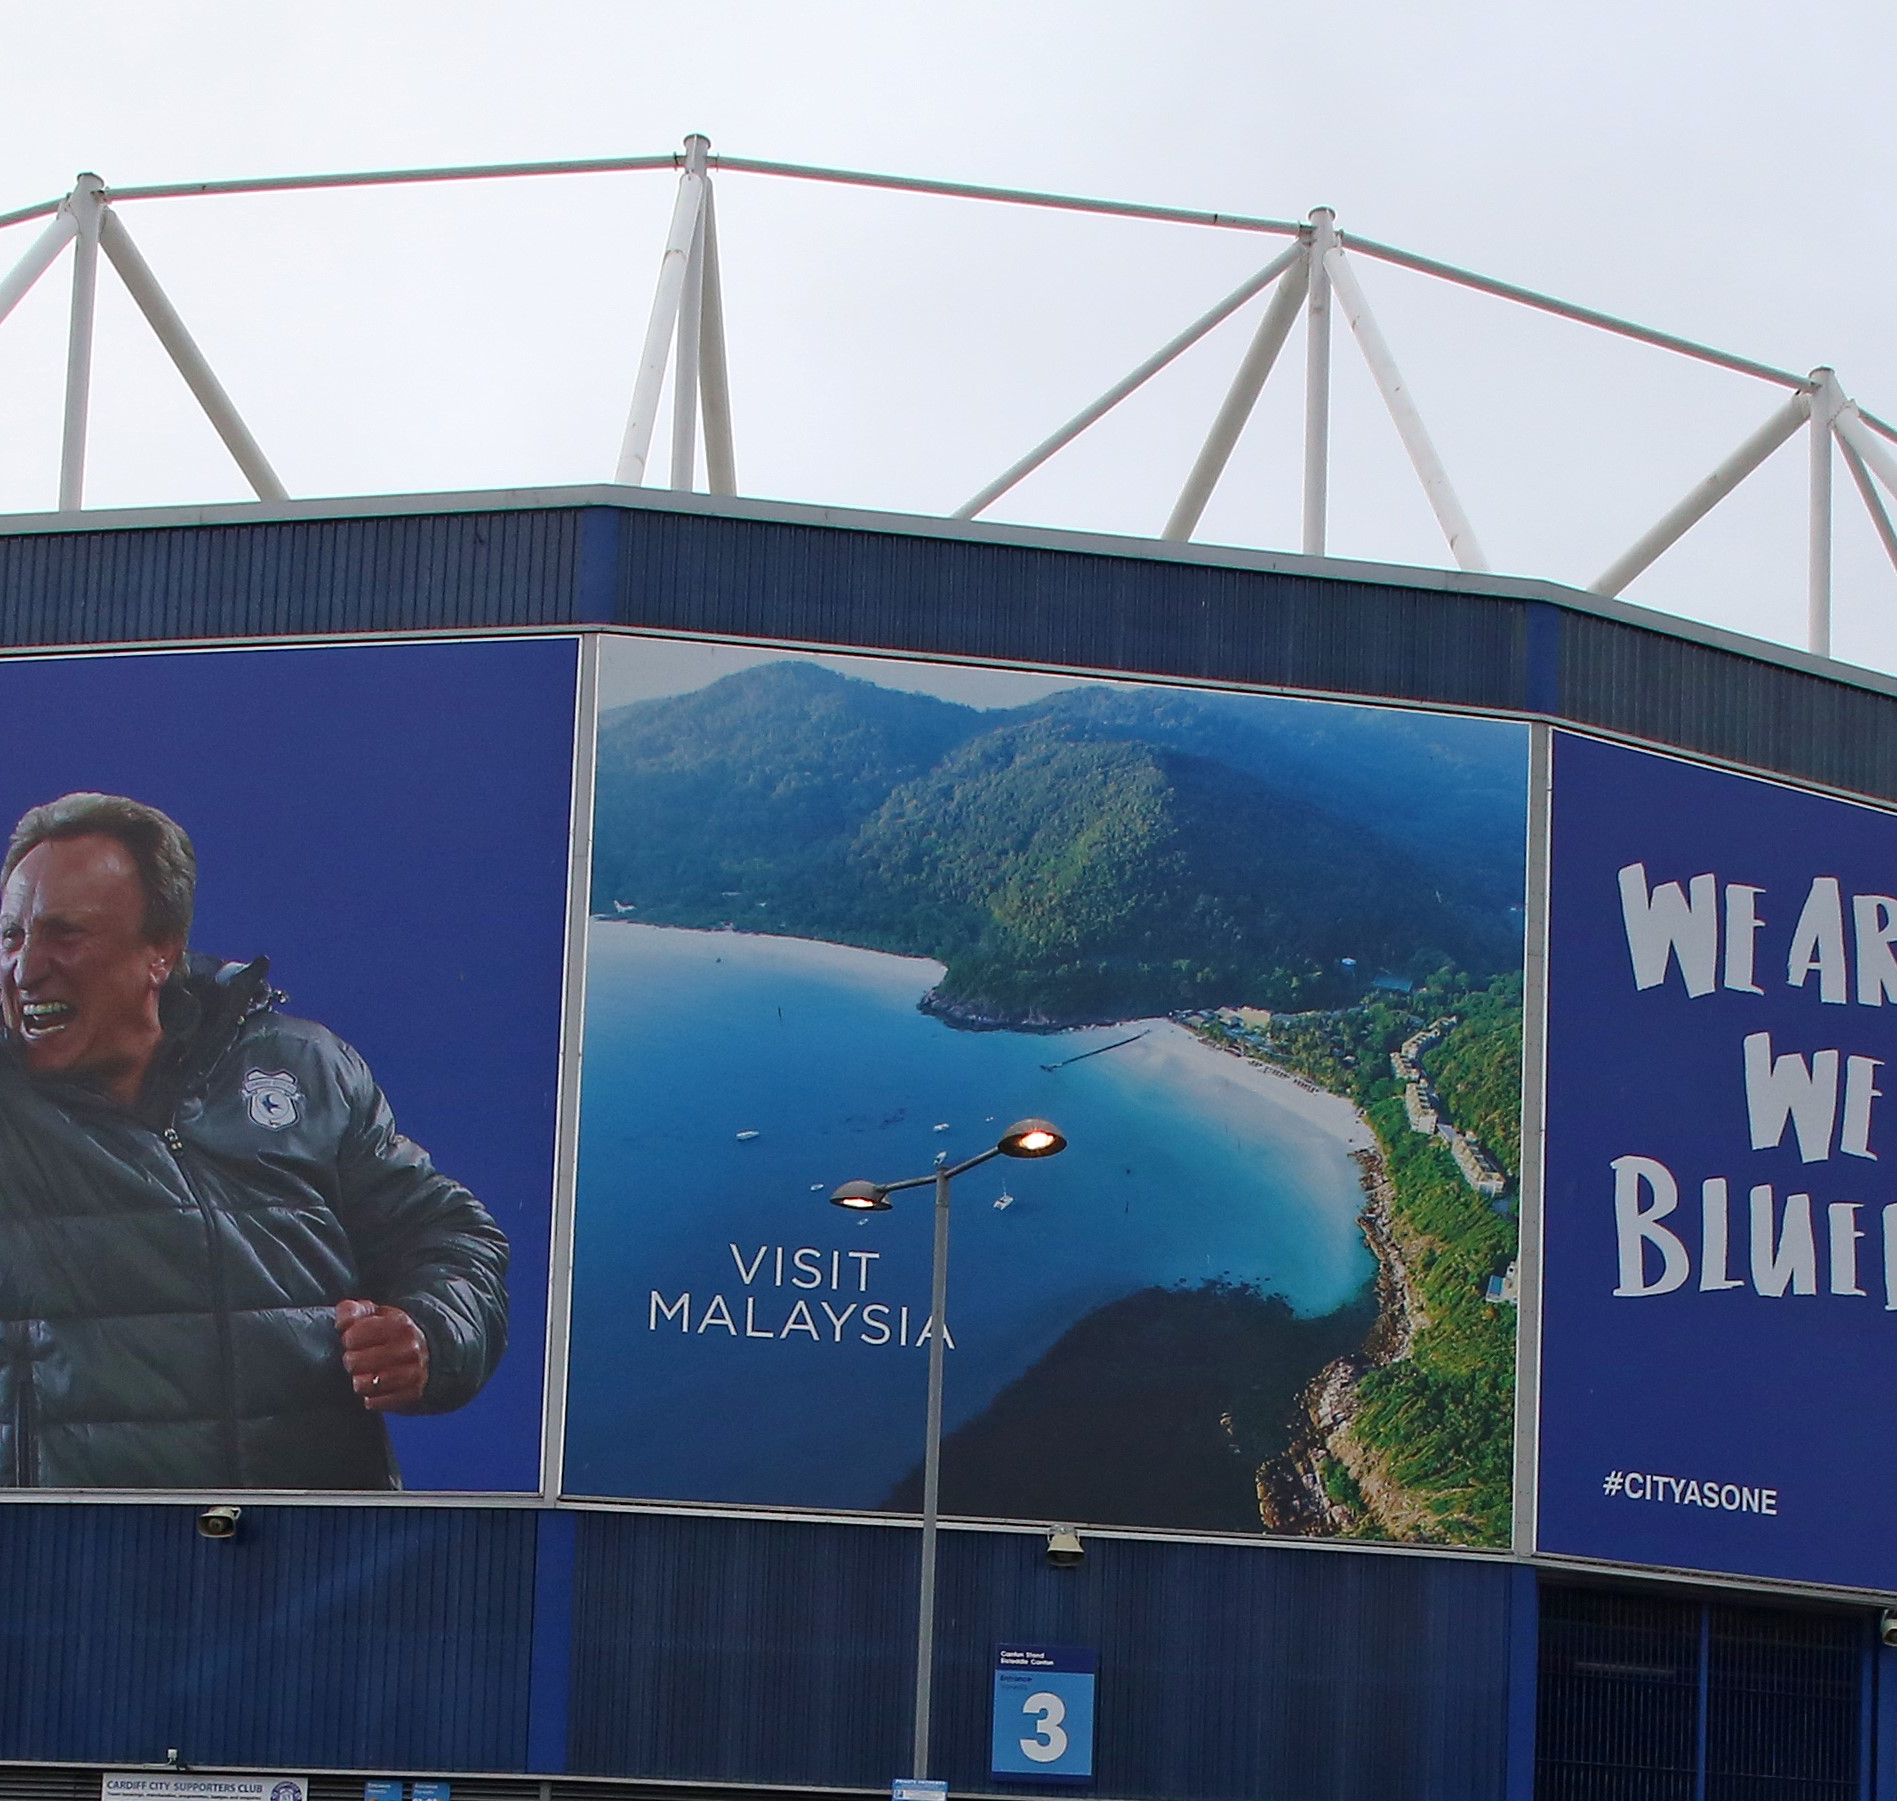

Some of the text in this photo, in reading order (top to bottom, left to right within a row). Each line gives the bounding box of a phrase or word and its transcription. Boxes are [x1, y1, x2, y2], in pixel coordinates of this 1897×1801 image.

[1618, 862, 1766, 998] WE
[1744, 1031, 1885, 1163] WE
[729, 1243, 880, 1292] VISIT
[649, 1290, 956, 1350] MALAYSIA
[1603, 1470, 1777, 1515] #CITYASONE
[1026, 1651, 1045, 1659] Stand
[1019, 1691, 1068, 1763] 3
[107, 1780, 263, 1793] CARDIFF CITY SUPPORTERS CLUB
